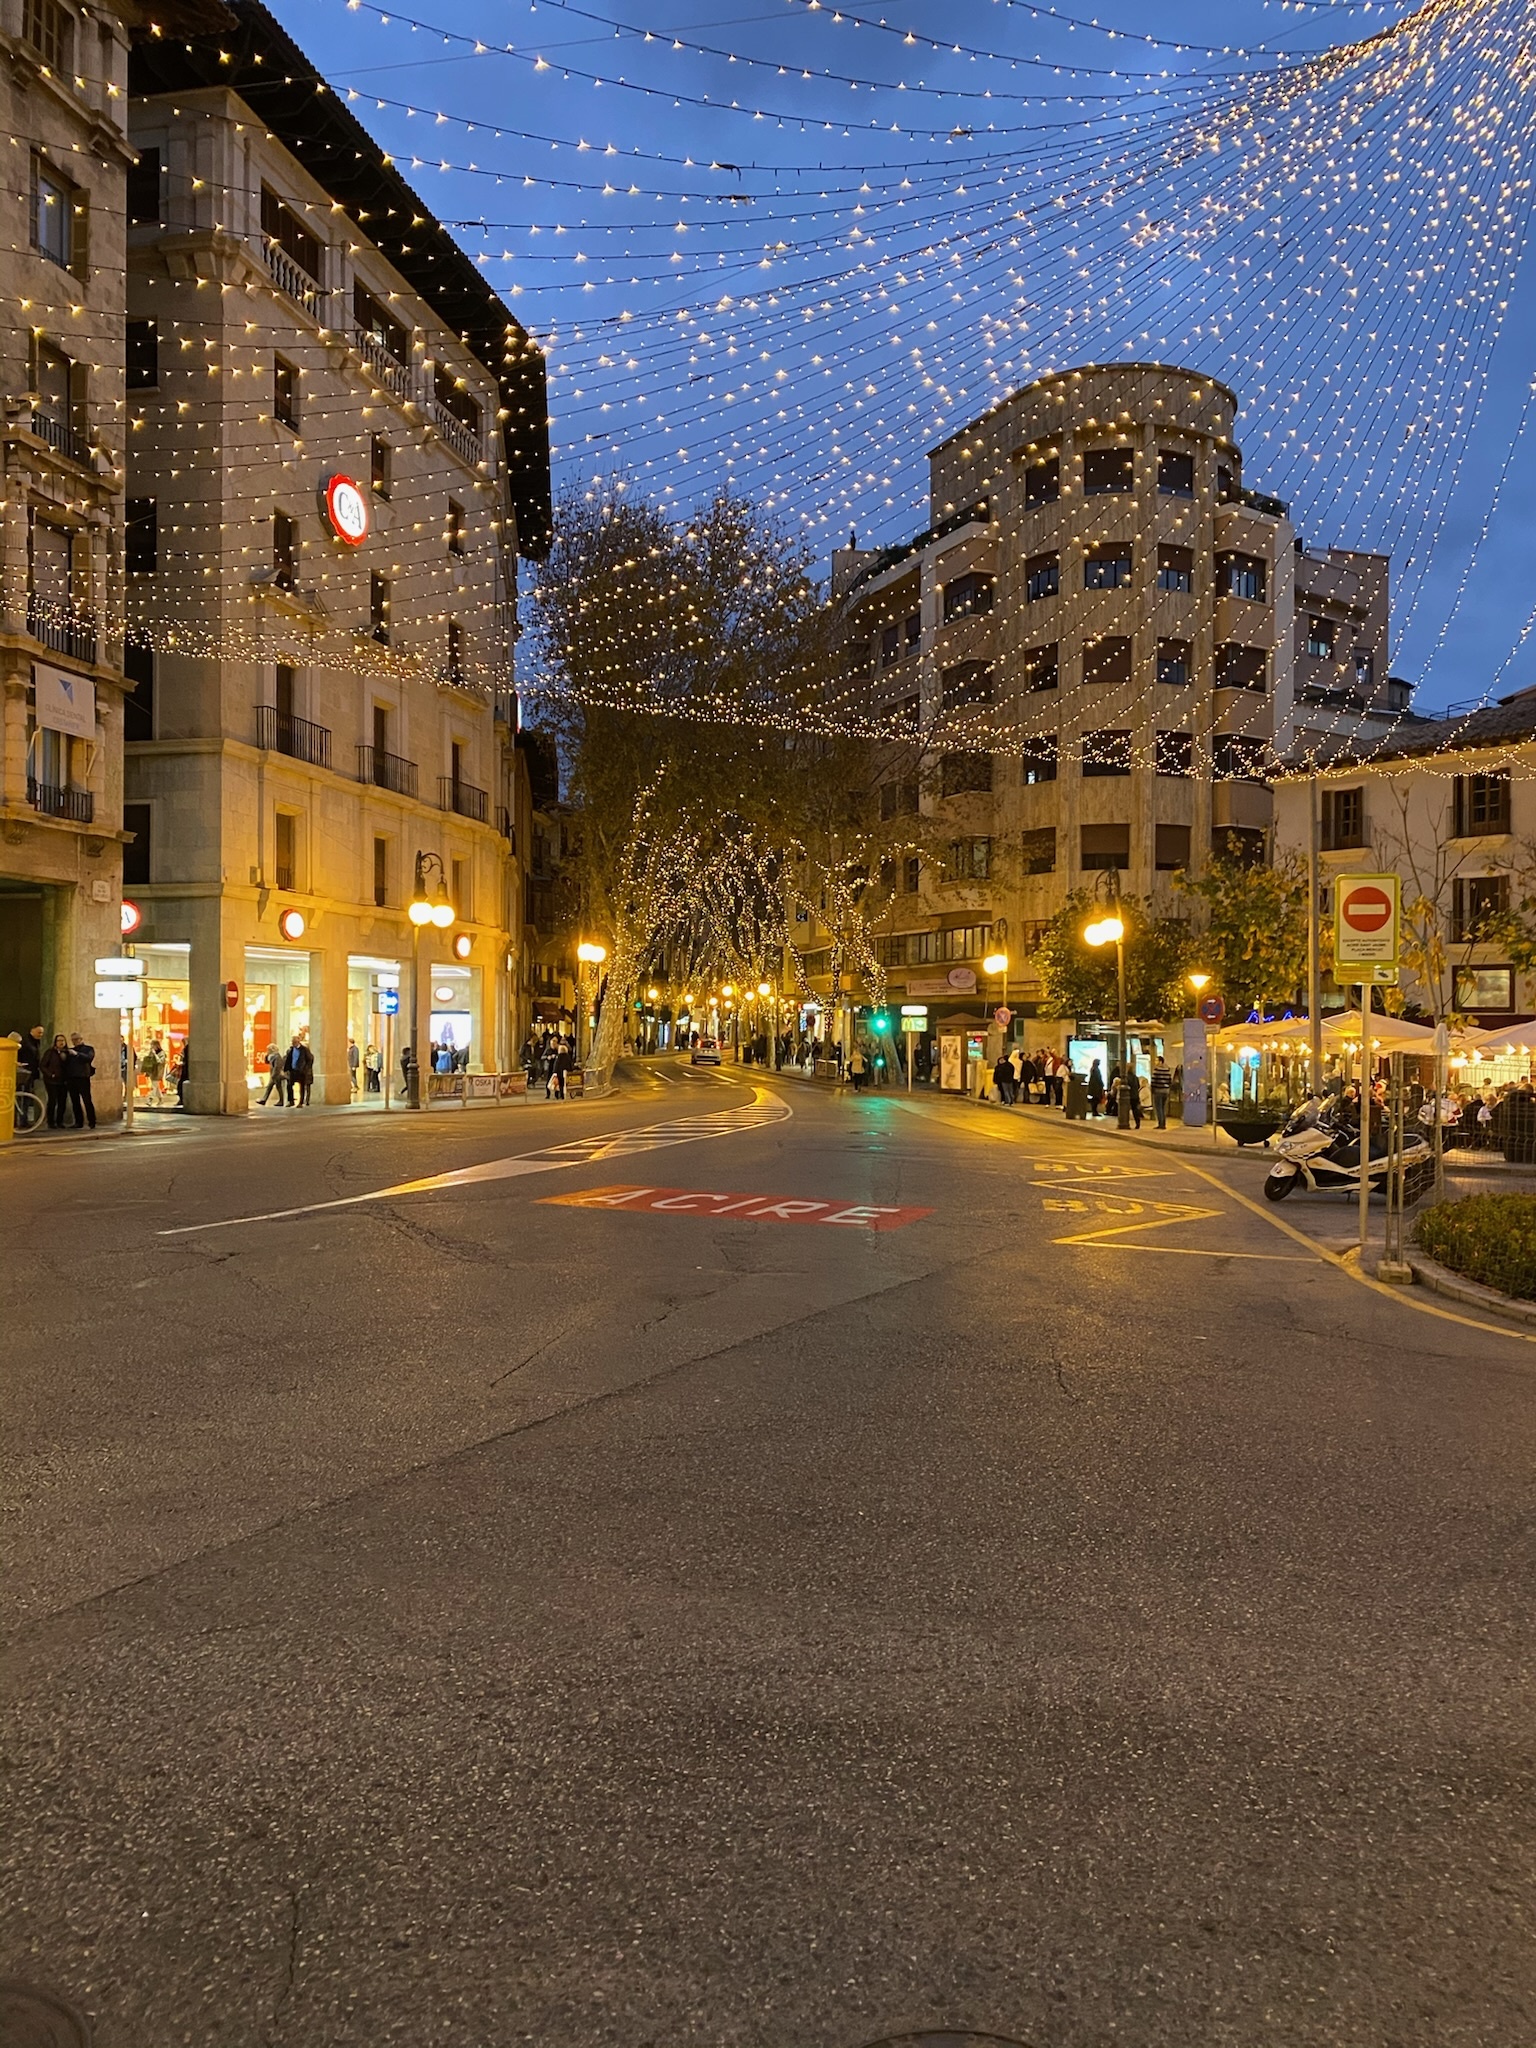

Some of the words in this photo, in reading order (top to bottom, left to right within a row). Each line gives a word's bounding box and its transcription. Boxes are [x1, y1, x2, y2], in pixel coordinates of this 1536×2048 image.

[475, 1078, 492, 1087] OSKA
[577, 1188, 901, 1225] ACIRE
[1043, 1199, 1202, 1216] BUS
